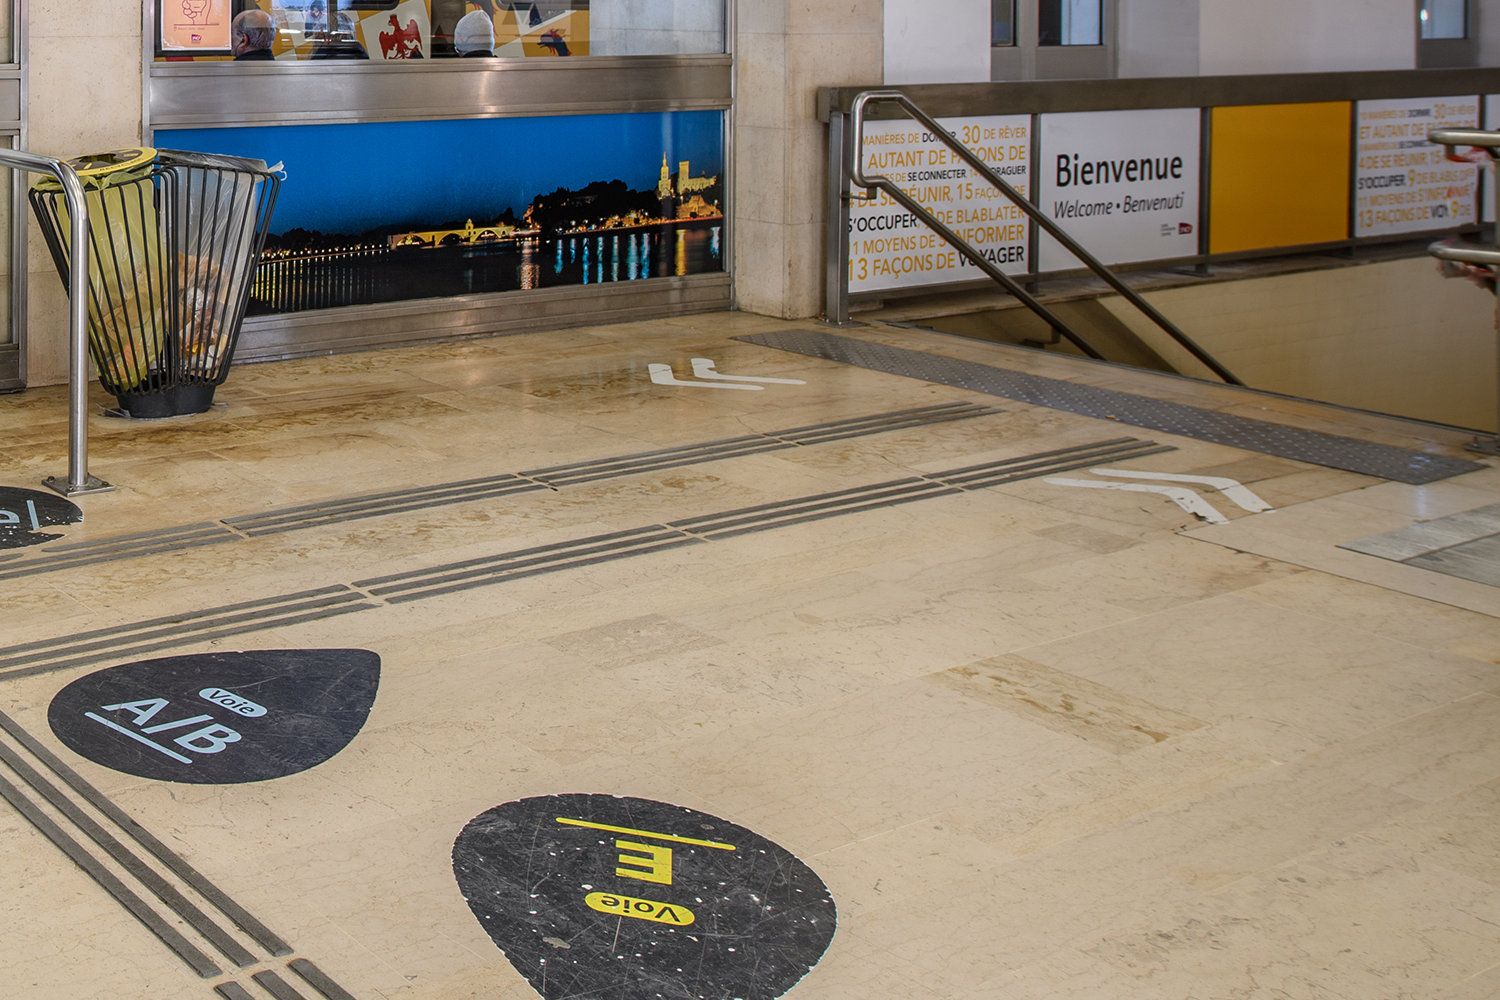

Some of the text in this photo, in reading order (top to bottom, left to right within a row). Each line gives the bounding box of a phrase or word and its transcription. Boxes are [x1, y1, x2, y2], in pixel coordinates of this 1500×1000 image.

[1434, 104, 1446, 119] 30
[908, 133, 919, 144] DE
[962, 125, 980, 145] 30
[984, 128, 996, 140] DE
[999, 125, 1027, 139] RÊVER
[1360, 123, 1424, 140] ET AUTANT DE
[868, 145, 1026, 170] AUTANT DE DE
[1367, 155, 1379, 169] DE
[896, 173, 906, 183] DE
[908, 172, 917, 182] SE
[1056, 152, 1184, 188] Bienvenue
[1408, 169, 1416, 187] 9
[957, 183, 973, 200] 15
[936, 205, 1025, 225] DE BLABLATER
[1054, 192, 1185, 220] Welcome Benvenuti
[1359, 205, 1429, 227] 13 FAÇONS DE
[864, 234, 936, 255] MOYENS DE
[849, 252, 955, 281] 13 FAÇONS DE
[209, 690, 255, 714] Voie
[101, 698, 242, 754] A/B
[616, 840, 673, 885] E
[601, 894, 681, 923] Voie
